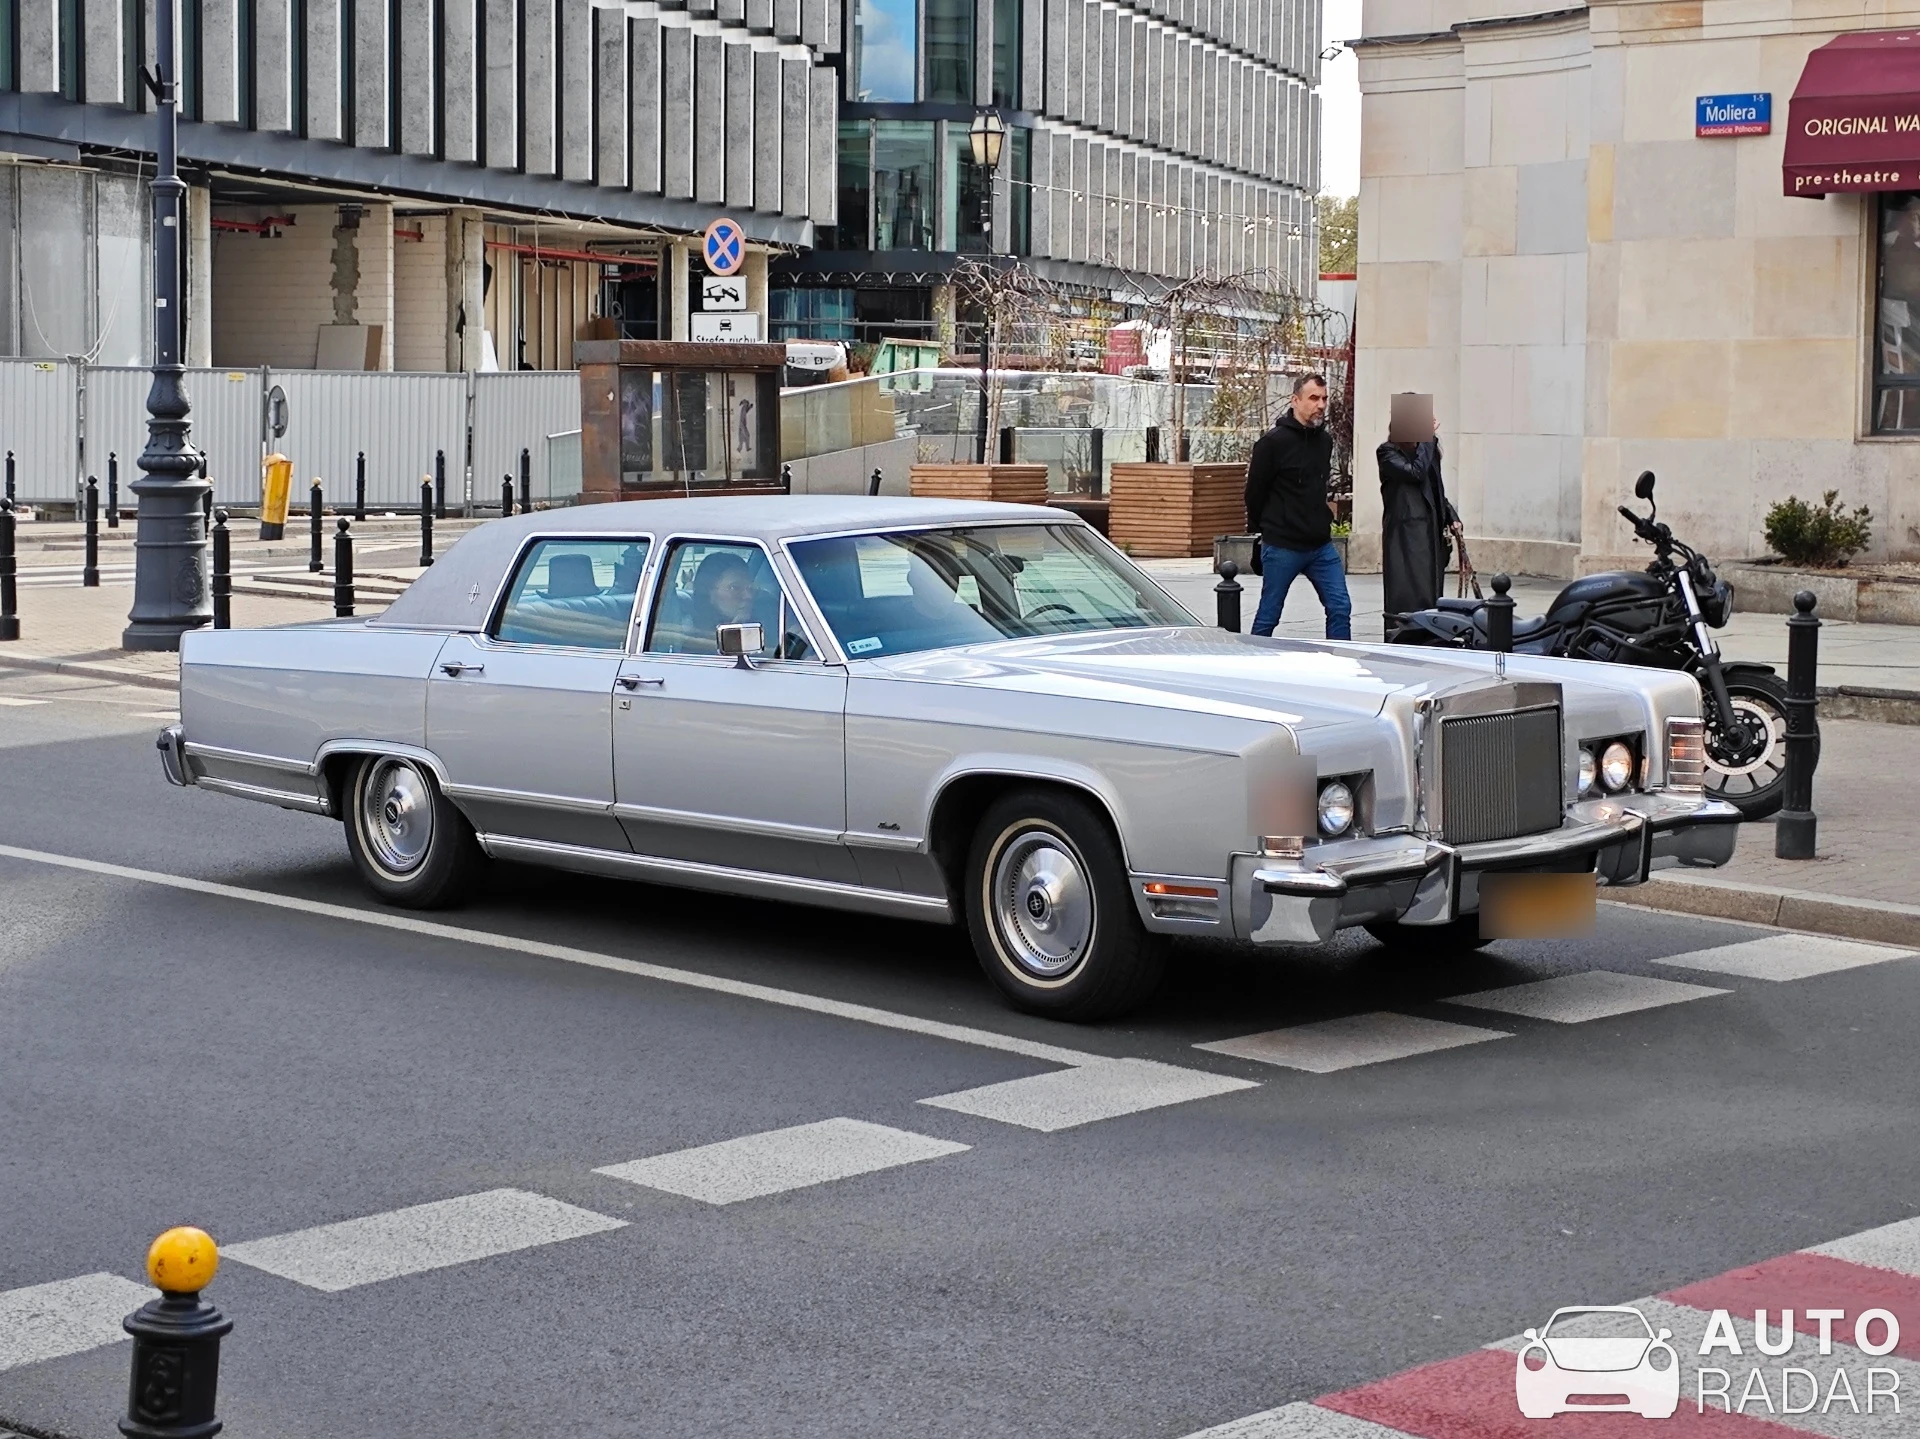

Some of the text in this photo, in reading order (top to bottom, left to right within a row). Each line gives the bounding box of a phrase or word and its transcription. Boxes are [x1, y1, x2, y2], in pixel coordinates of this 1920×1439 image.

[1752, 94, 1764, 102] 1-5
[1706, 104, 1756, 122] Moliera
[1804, 116, 1888, 136] ORIGINAL
[1795, 169, 1900, 191] pre-theatre
